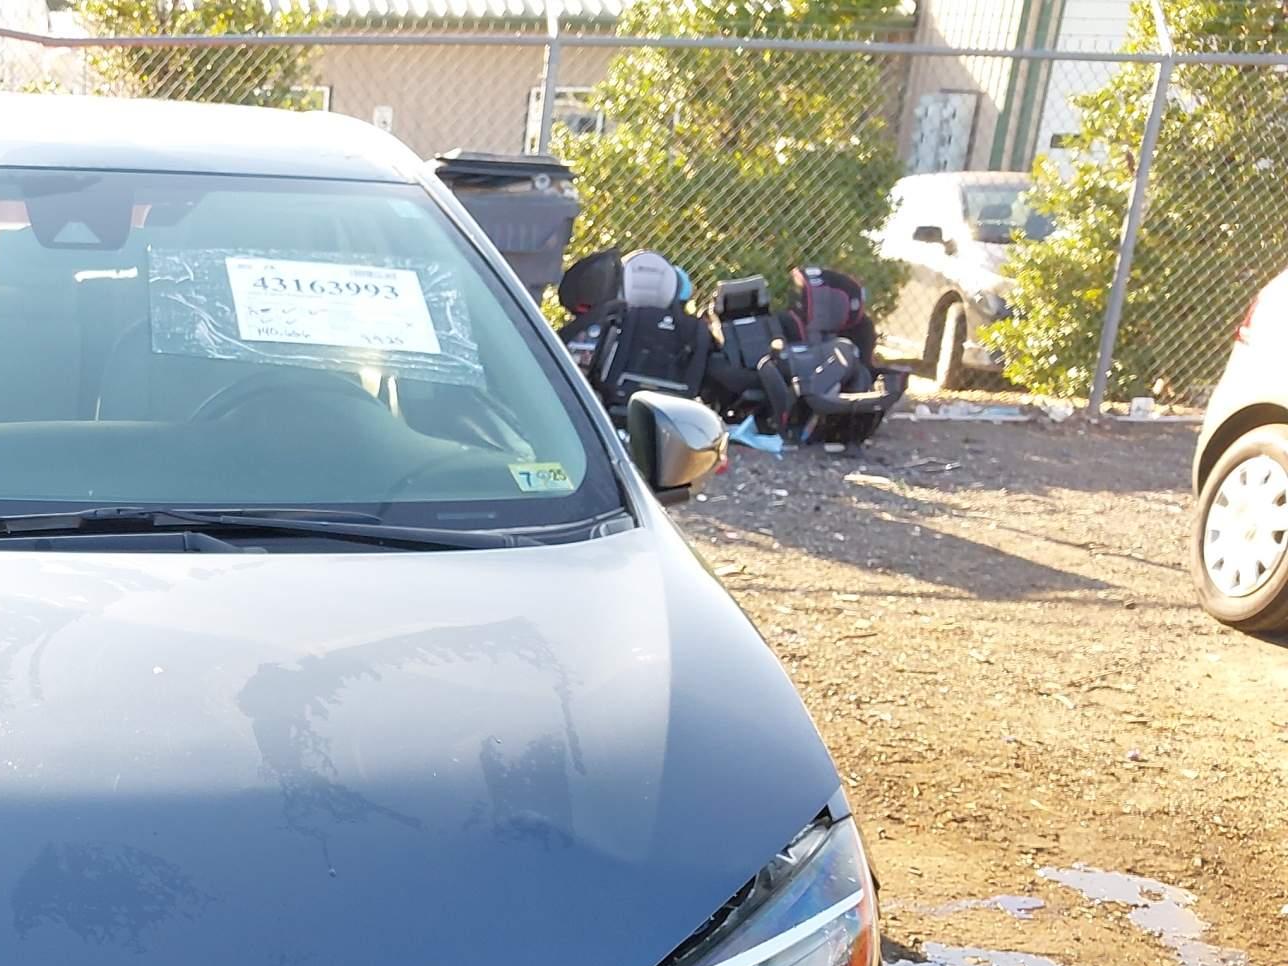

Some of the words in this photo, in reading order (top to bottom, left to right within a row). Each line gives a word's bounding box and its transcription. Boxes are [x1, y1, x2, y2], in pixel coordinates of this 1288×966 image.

[253, 275, 399, 300] 43163993
[518, 471, 532, 488] 7
[548, 468, 567, 481] 25
